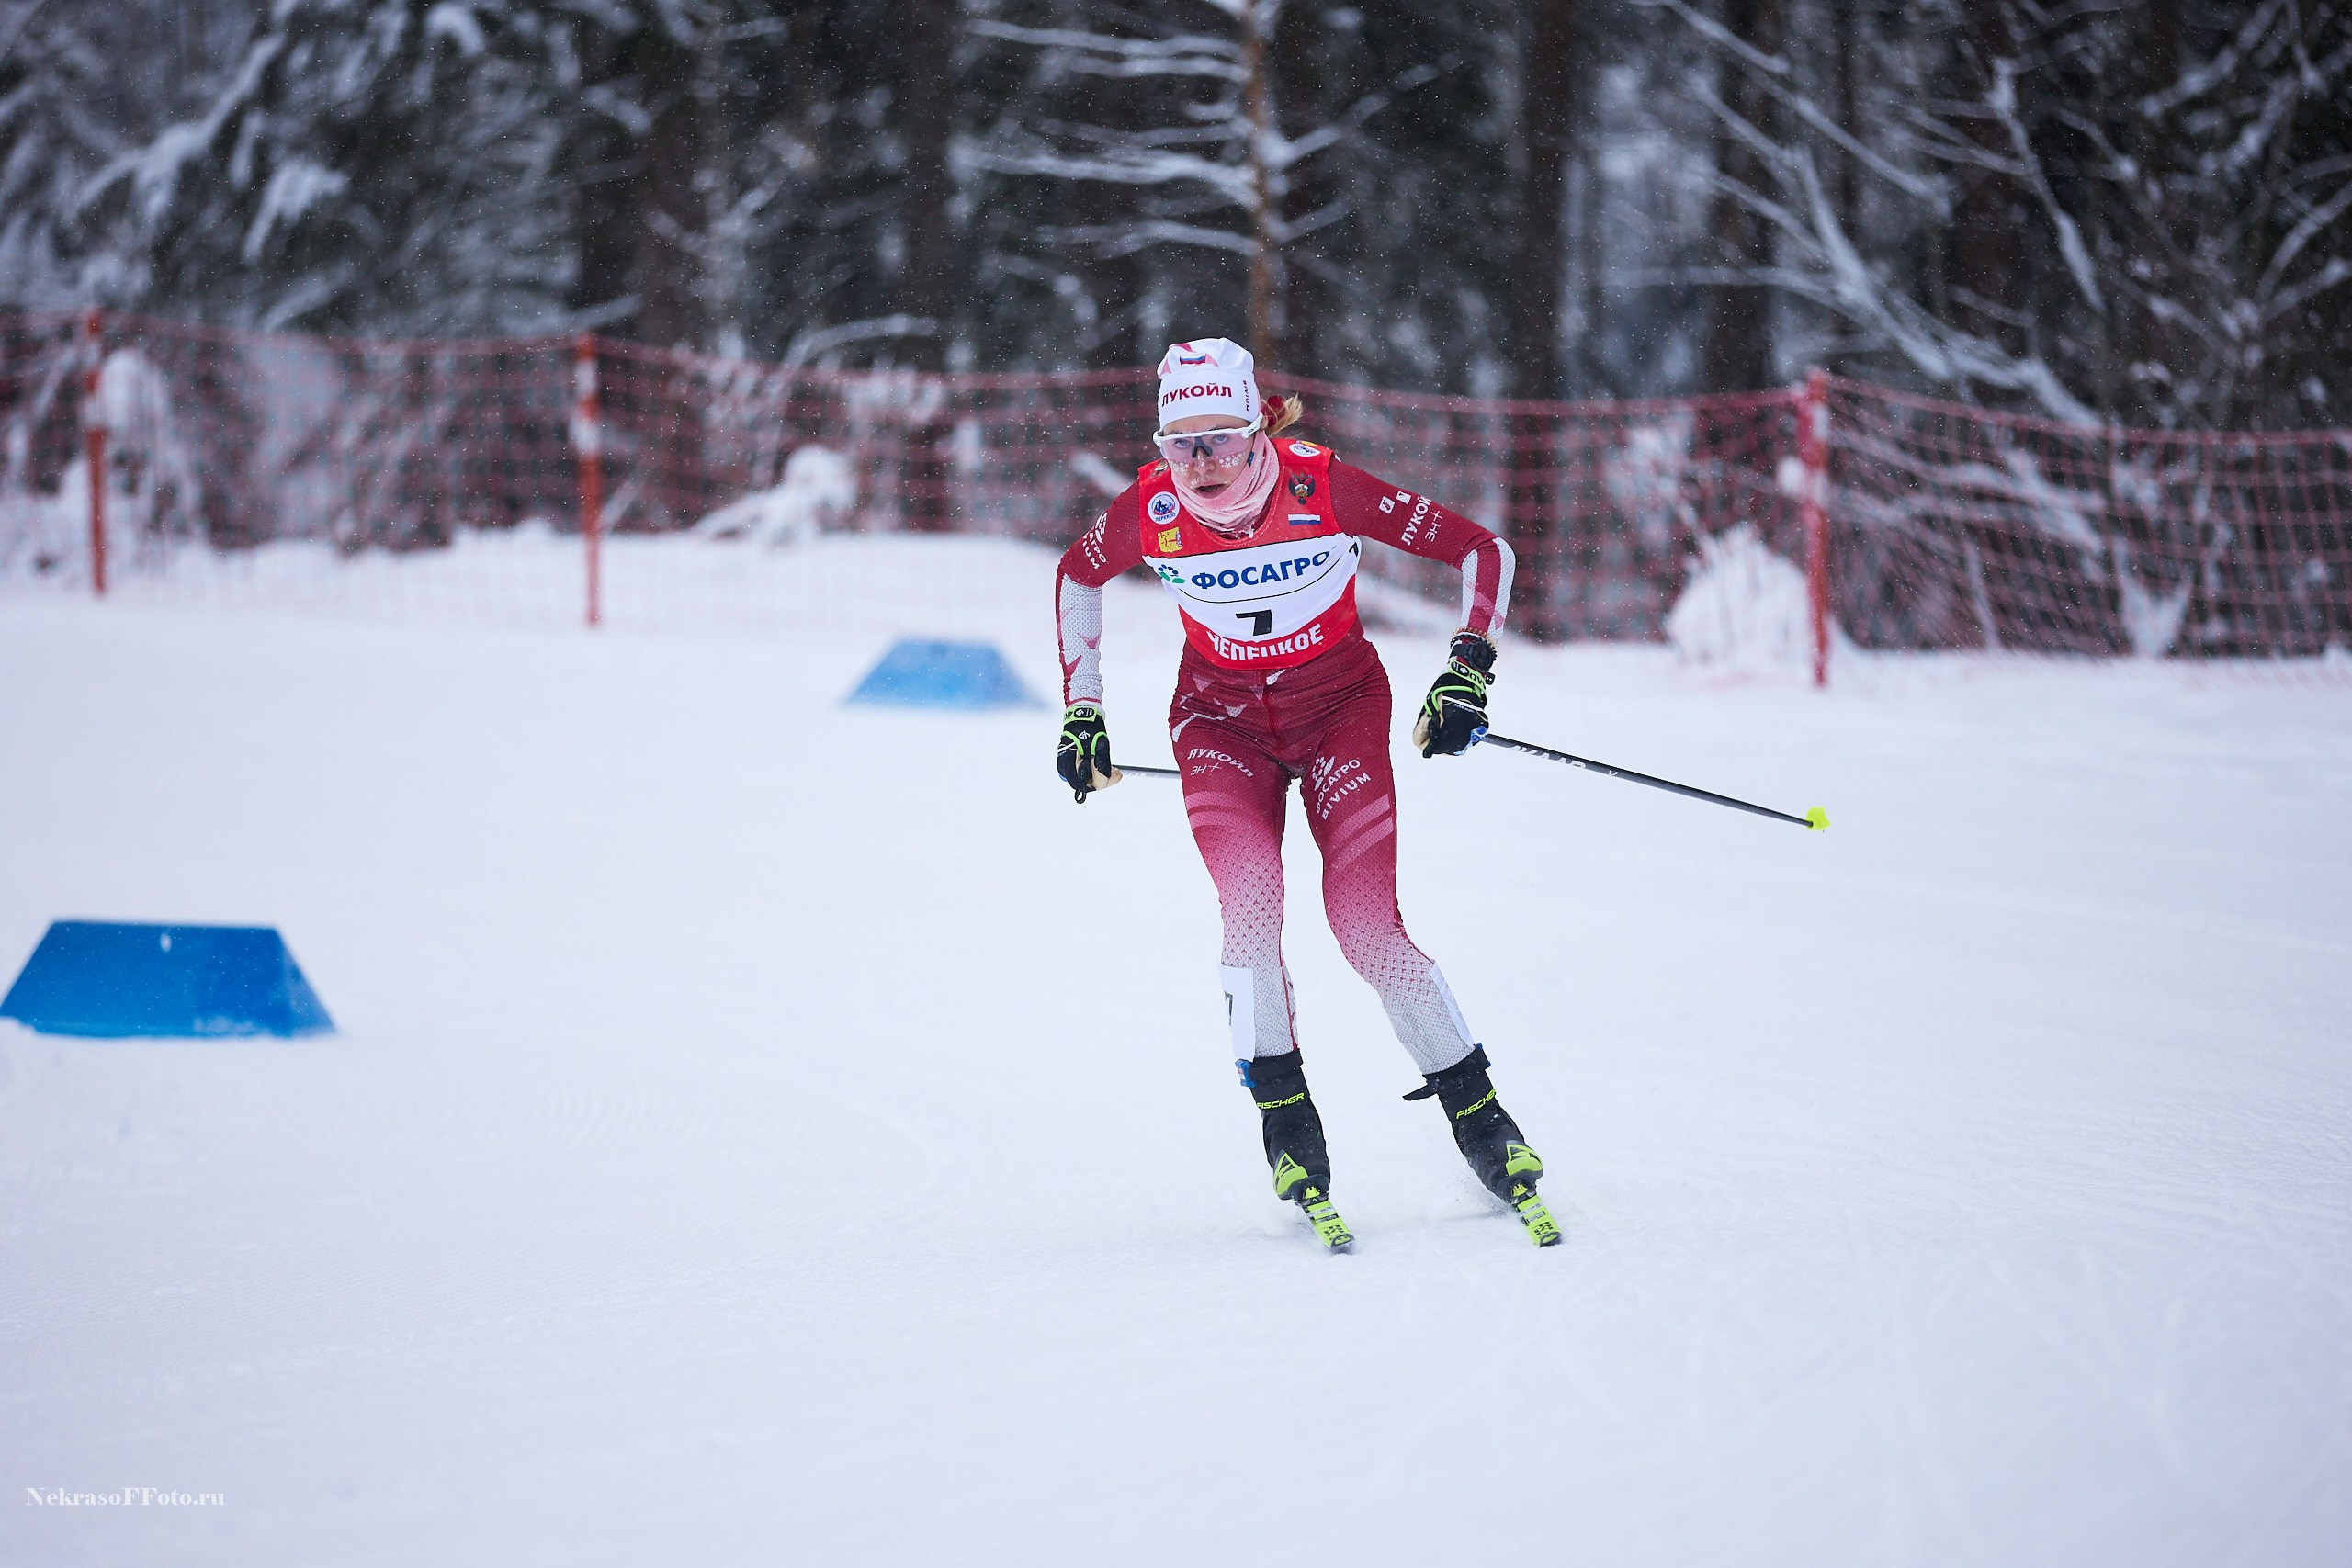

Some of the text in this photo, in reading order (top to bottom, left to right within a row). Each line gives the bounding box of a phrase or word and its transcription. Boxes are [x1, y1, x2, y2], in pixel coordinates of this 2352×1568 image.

[1161, 382, 1232, 407] ЛУКОЙЛ
[1401, 495, 1432, 546] ЛУКОЙ
[1191, 550, 1331, 590] ФОСАГРО
[1235, 609, 1272, 637] 7
[1187, 748, 1254, 777] ЛУКОЙЛ
[1316, 759, 1361, 814] ФОСАГРО
[1321, 773, 1372, 821] BIVIUM
[1256, 1092, 1305, 1110] FISCHER
[1455, 1088, 1497, 1120] FISCHE
